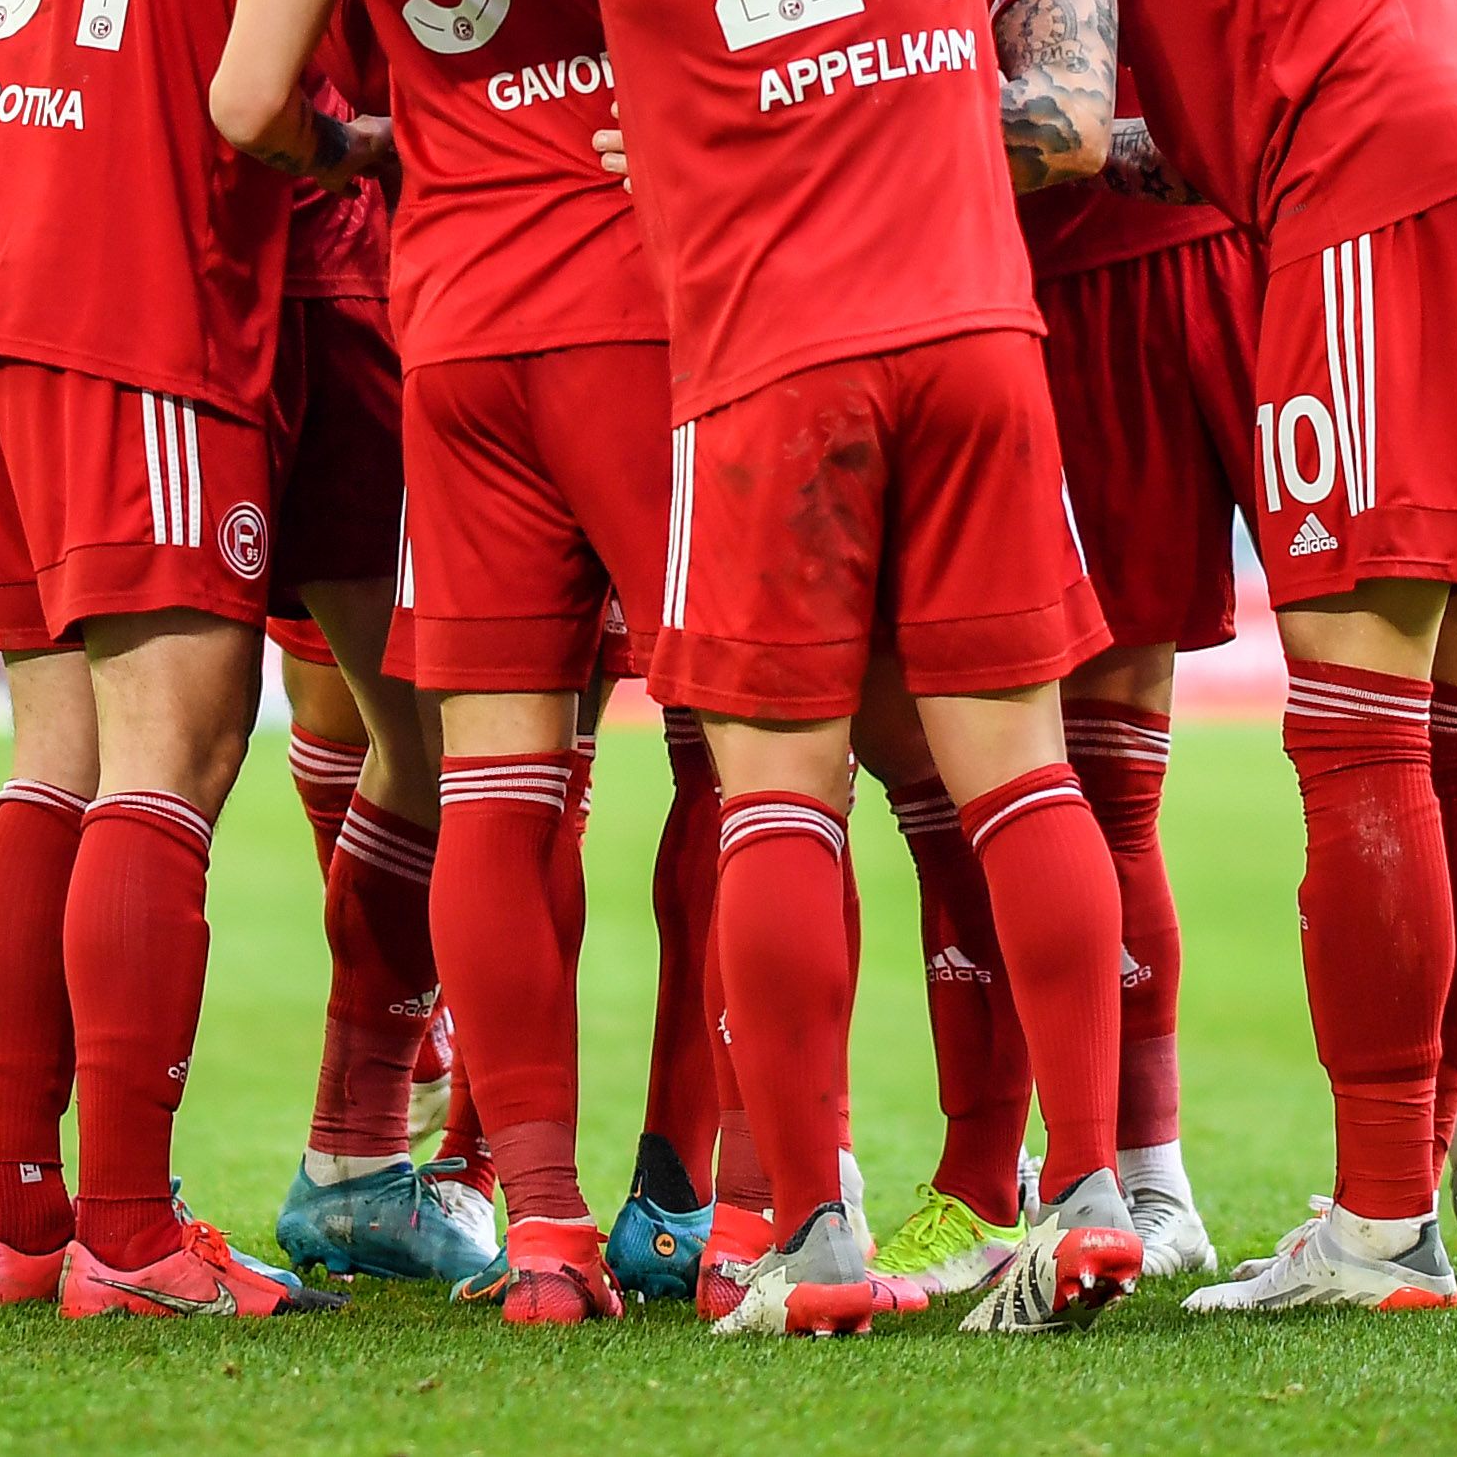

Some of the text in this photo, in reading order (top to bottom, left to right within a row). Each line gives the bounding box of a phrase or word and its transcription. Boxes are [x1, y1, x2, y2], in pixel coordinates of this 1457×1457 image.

[758, 28, 977, 112] APPELKAM
[1256, 394, 1337, 514] 10
[1289, 536, 1339, 557] adidas
